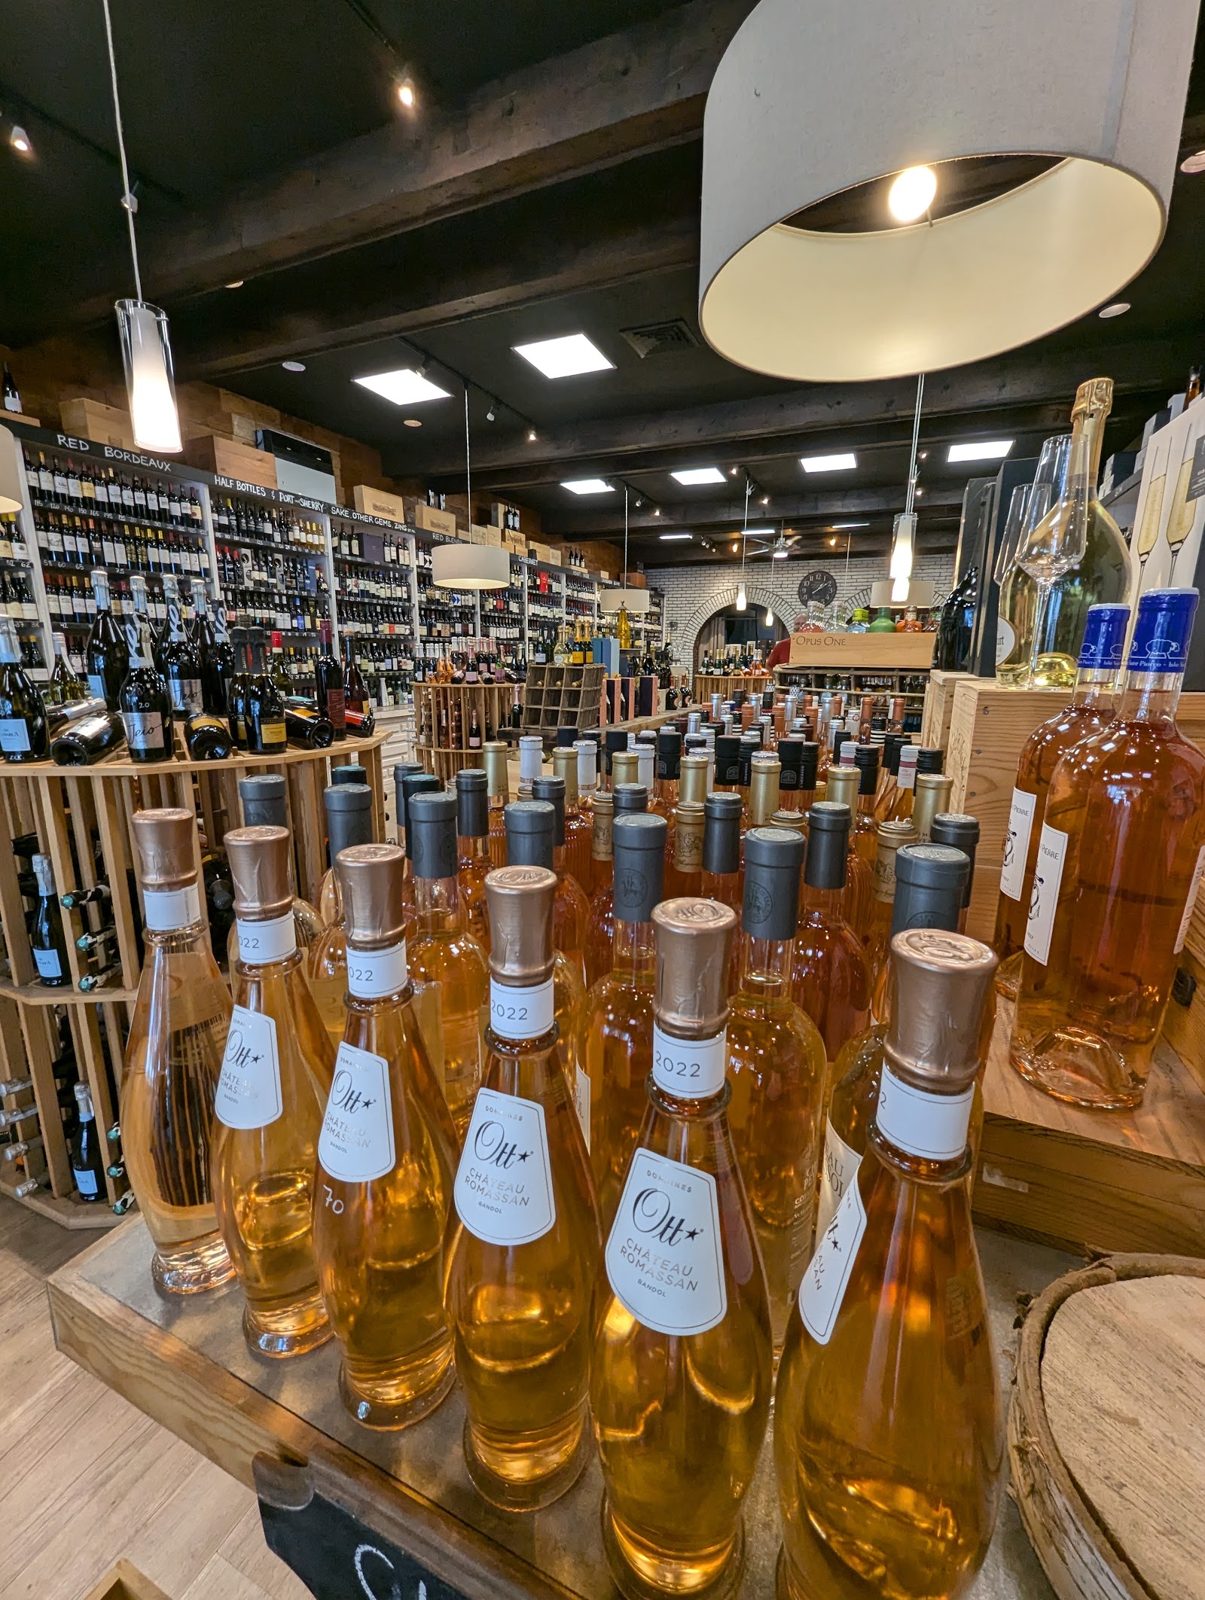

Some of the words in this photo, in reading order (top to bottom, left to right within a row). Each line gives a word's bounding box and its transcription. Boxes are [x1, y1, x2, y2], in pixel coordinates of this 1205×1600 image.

[56, 434, 90, 451] RED
[104, 445, 172, 472] BORDEAUX
[214, 474, 234, 488] HALF
[236, 480, 266, 497] BOTTLES
[352, 512, 374, 524] OTHER
[432, 532, 444, 541] RED
[492, 1000, 528, 1020] 2022
[226, 1030, 251, 1068] Ott
[656, 1050, 701, 1078] 2022
[331, 1070, 362, 1114] Ott
[475, 1120, 518, 1170] Ott
[465, 1175, 530, 1206] ROMASSAN
[469, 1168, 525, 1194] CHÂTEAU
[323, 1184, 344, 1214] 70
[632, 1188, 686, 1247] Ott
[620, 1246, 699, 1292] ROMASSAN
[626, 1238, 693, 1277] CHÂTEAU
[637, 1278, 667, 1298] BANDOL
